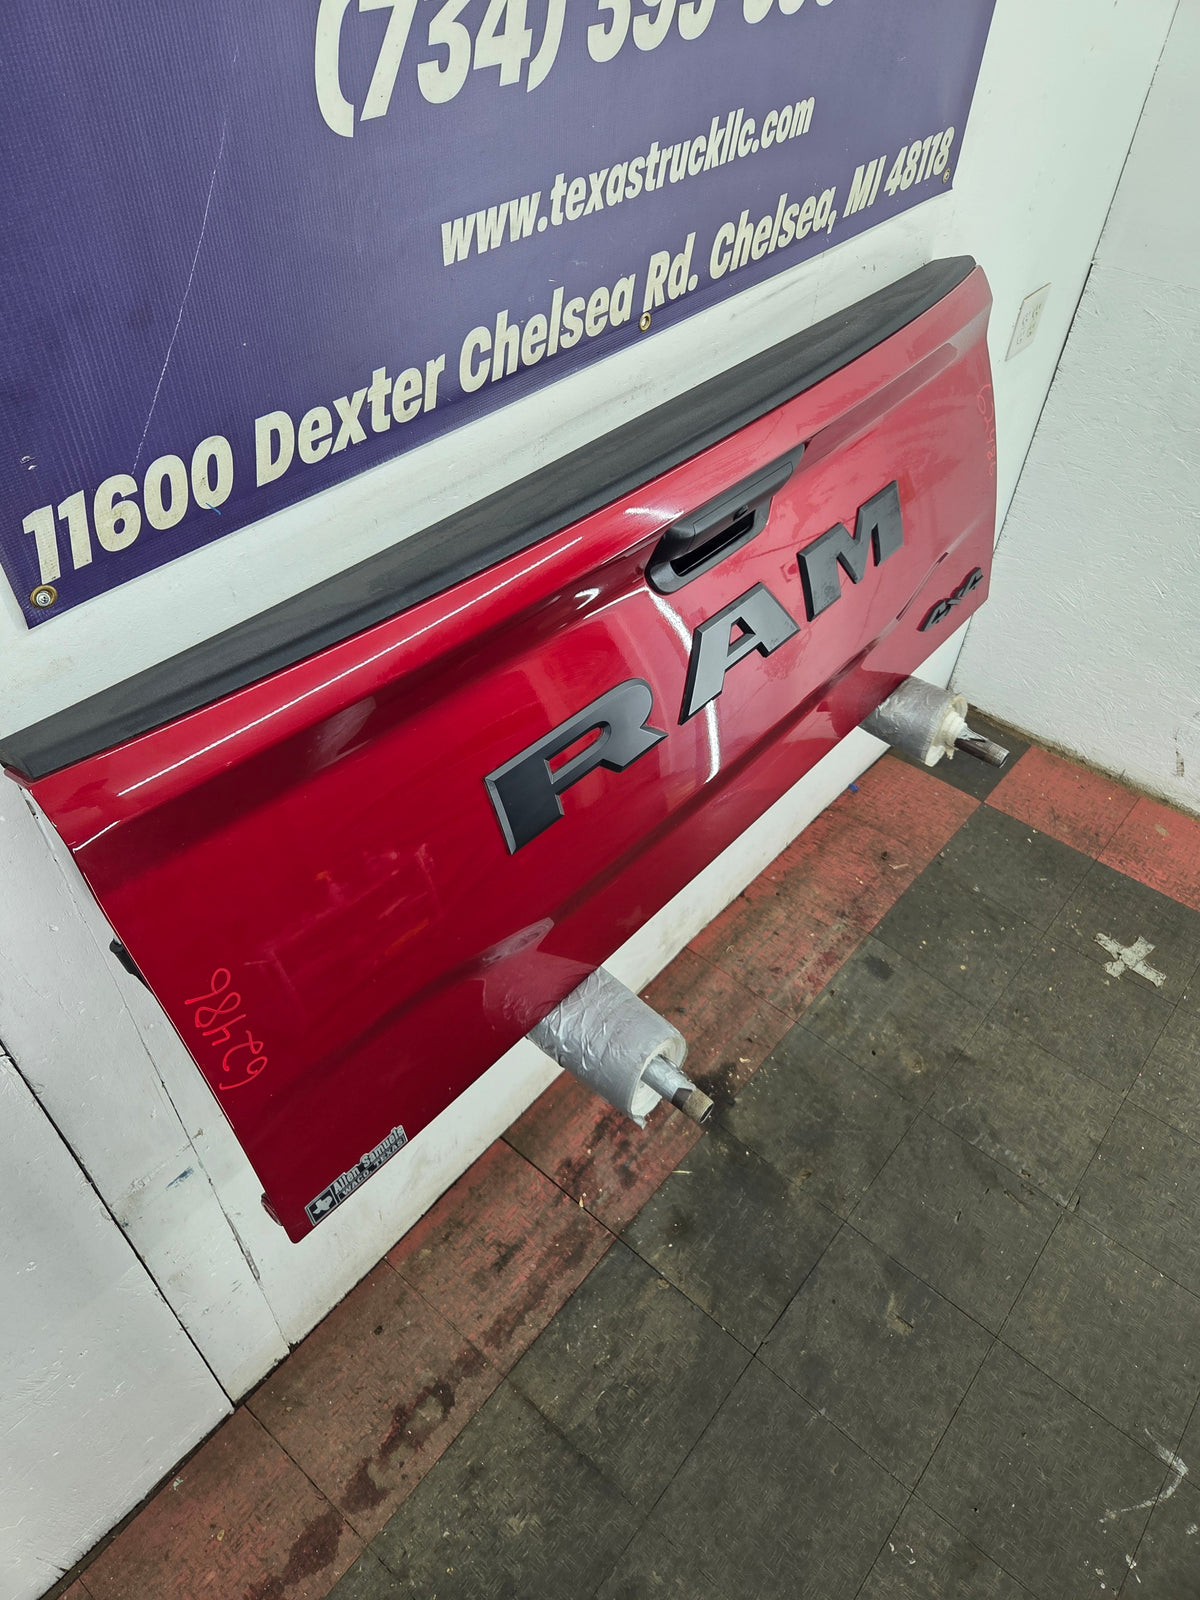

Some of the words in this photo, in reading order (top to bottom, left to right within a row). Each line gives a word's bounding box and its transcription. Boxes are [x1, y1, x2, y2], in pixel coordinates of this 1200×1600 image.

[441, 96, 815, 266] www.texastruckllc.com
[22, 435, 234, 585] 11600
[255, 354, 446, 487] Dexter
[459, 274, 636, 393] Chelsea
[642, 231, 699, 313] Rd.
[709, 187, 837, 279] Chelsea,
[842, 155, 887, 218] MI
[883, 126, 955, 196] 48118
[484, 480, 905, 855] RAM
[184, 967, 268, 1090] 62486
[331, 1165, 361, 1195] Allen
[360, 1125, 405, 1169] Samuels
[372, 1138, 404, 1167] TEXAS
